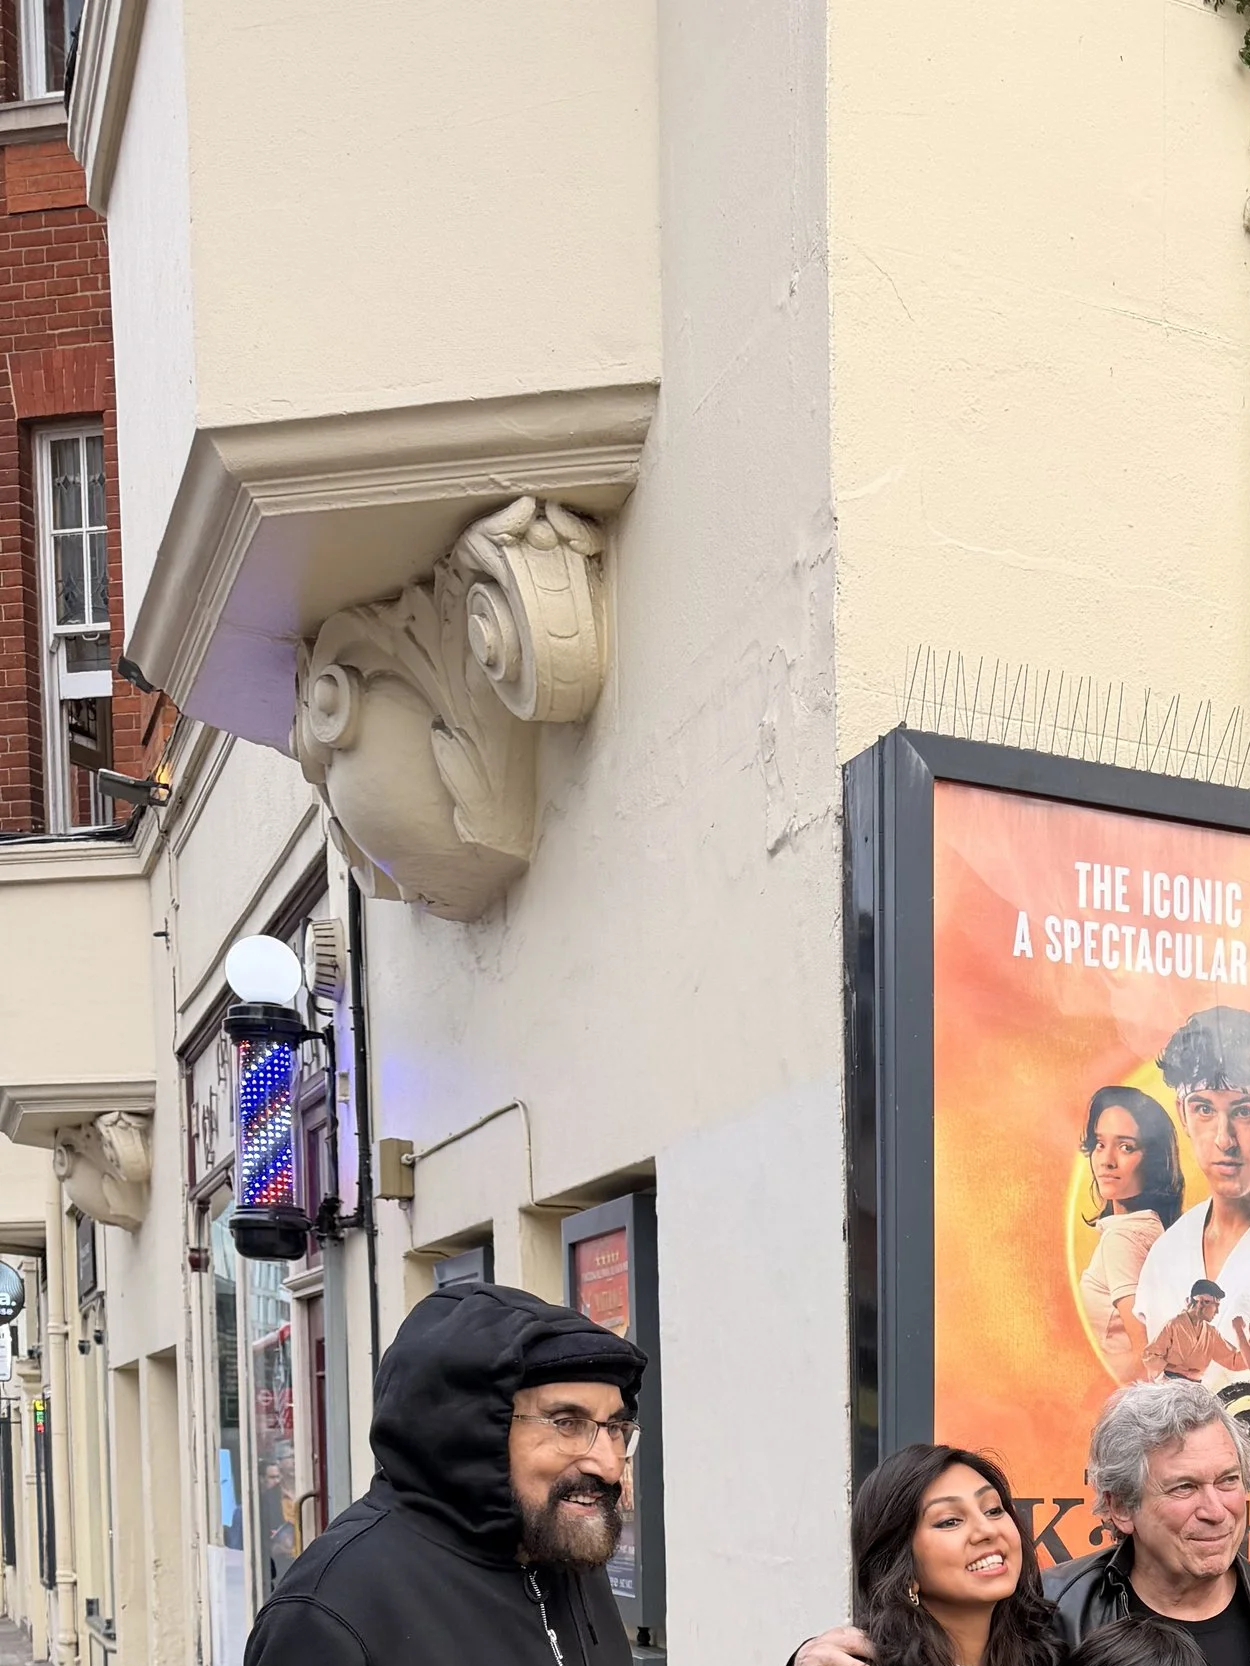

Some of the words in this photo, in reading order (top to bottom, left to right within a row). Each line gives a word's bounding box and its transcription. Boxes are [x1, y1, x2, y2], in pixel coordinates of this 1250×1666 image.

[1074, 861, 1131, 913] THE
[1142, 870, 1242, 929] ICONIC
[1012, 911, 1034, 959] A
[1044, 914, 1248, 986] SPECTACULAR
